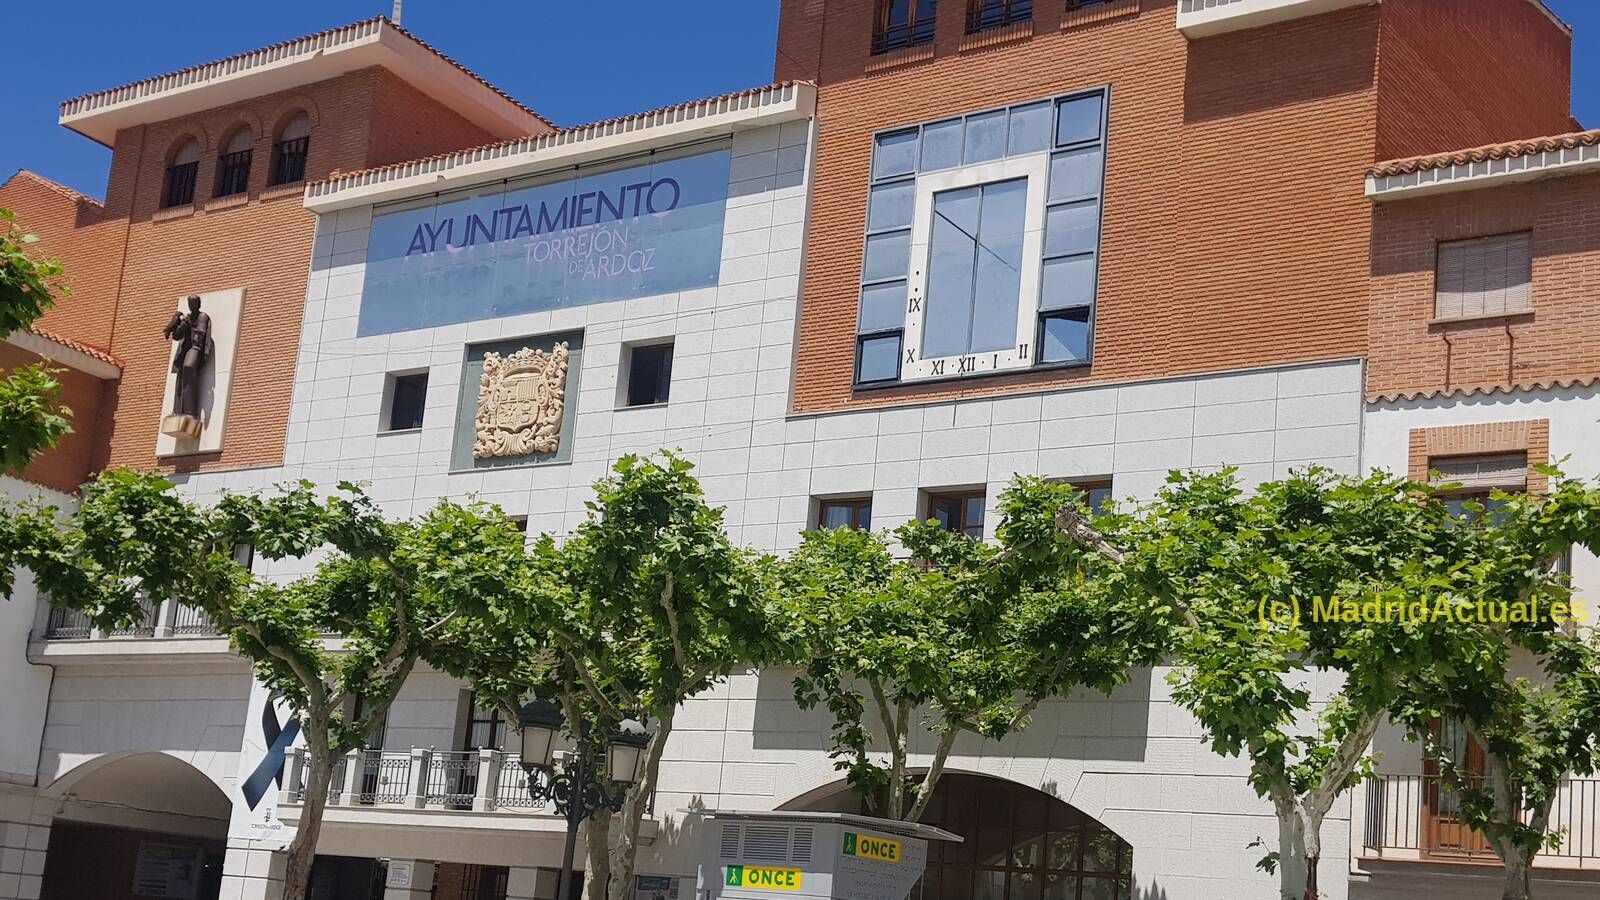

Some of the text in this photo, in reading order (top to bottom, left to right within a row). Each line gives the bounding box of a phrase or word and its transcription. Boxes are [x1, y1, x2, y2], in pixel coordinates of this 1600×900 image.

[405, 177, 680, 257] AYUNTAMIENTO
[524, 225, 630, 264] TORREJÓN
[568, 248, 657, 281] DE ARDOZ
[908, 297, 922, 313] IX
[906, 349, 915, 364] X
[931, 360, 945, 376] XI
[958, 357, 976, 373] XII
[1019, 344, 1029, 359] II
[861, 839, 897, 859] ONCE
[749, 869, 795, 886] ONCE
